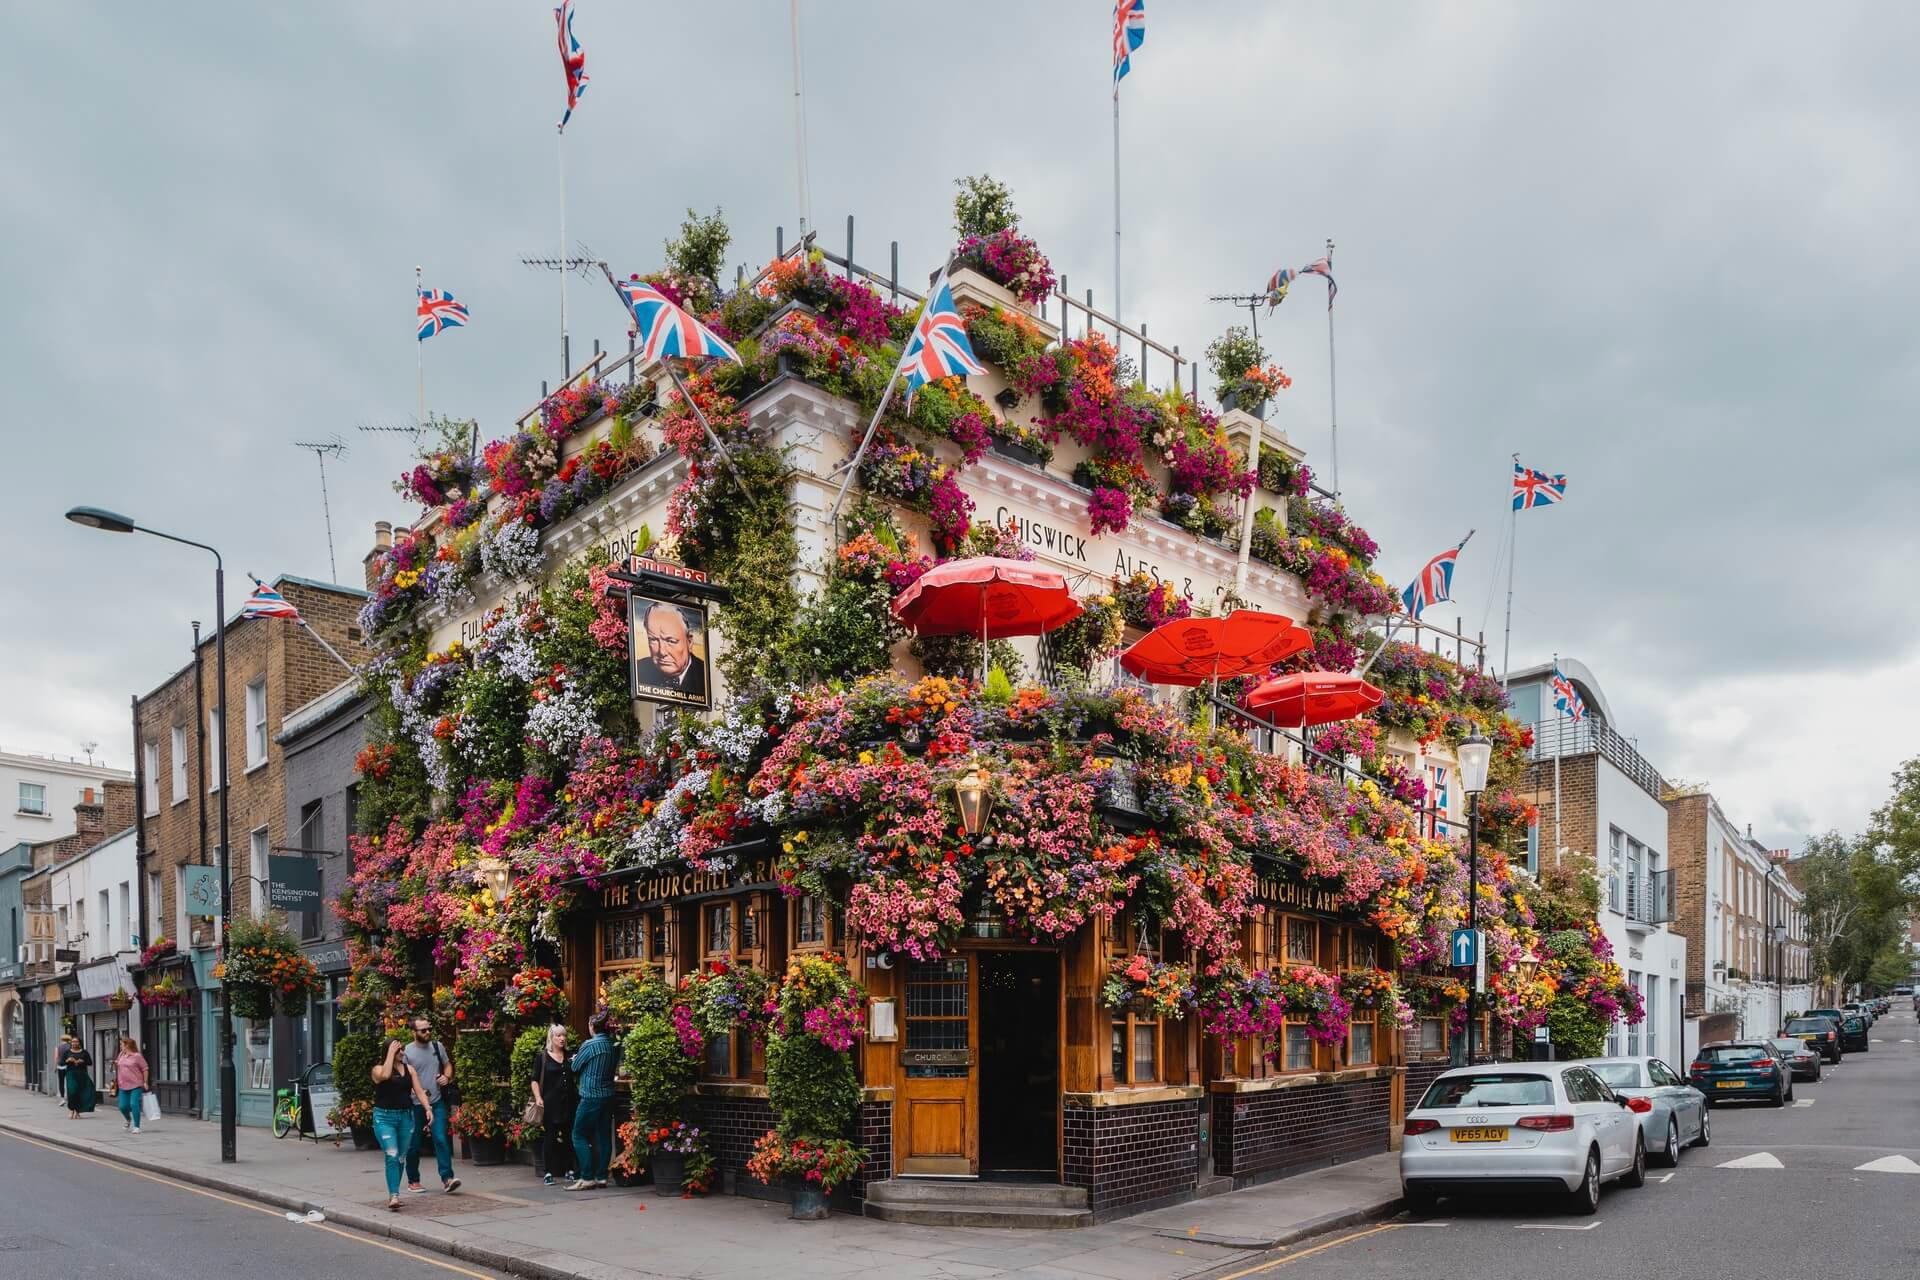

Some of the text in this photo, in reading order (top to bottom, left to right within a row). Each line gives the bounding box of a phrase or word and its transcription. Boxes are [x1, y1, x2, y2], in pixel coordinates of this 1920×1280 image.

[996, 506, 1087, 562] CHISWICK
[1183, 577, 1194, 602] &
[639, 685, 705, 703] THE CHURCHILL ARMS
[271, 888, 319, 897] KENSINGTON
[602, 885, 629, 908] THE
[637, 867, 729, 902] CHURCHILL
[1455, 1129, 1504, 1140] VF65 AGV
